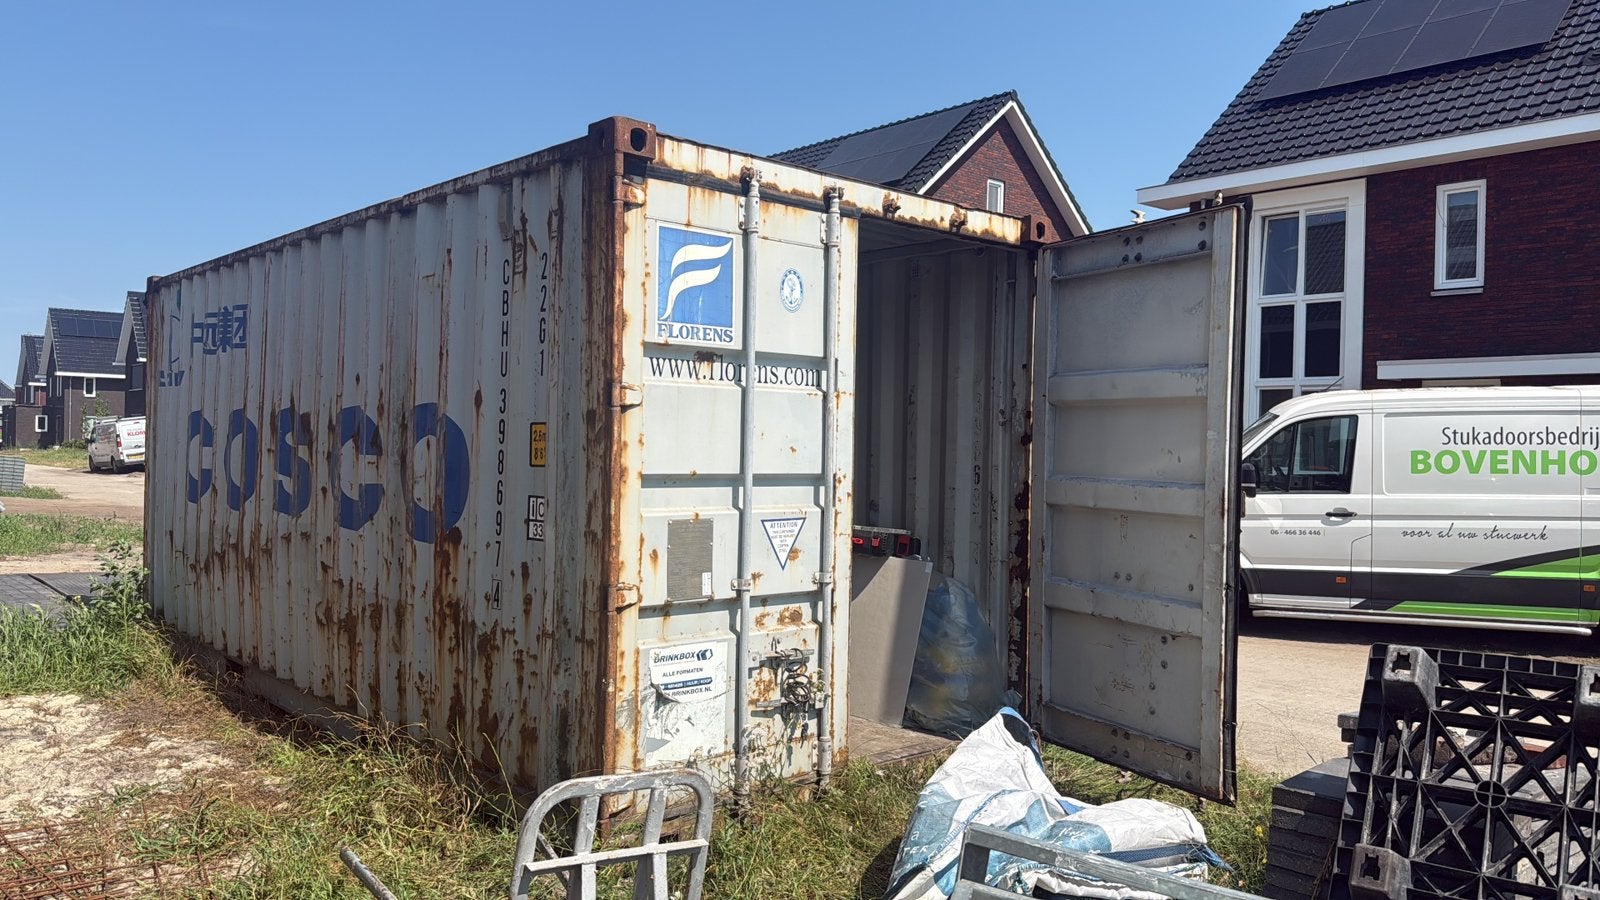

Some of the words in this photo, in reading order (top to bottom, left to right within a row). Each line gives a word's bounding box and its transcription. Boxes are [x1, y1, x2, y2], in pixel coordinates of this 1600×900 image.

[501, 259, 510, 377] CBHU
[539, 252, 548, 376] 22G1
[657, 323, 733, 343] FLORENS
[650, 355, 821, 387] www.florns.com
[187, 402, 470, 544] COSCO
[1410, 449, 1598, 476] BOVENHO
[495, 388, 507, 567] 398697
[532, 523, 544, 538] 33
[1401, 529, 1432, 538] voor
[1438, 522, 1454, 539] al
[1458, 530, 1478, 539] uw
[1483, 525, 1548, 541] stucwerk
[493, 581, 500, 608] 4
[676, 667, 703, 675] FORMATEN
